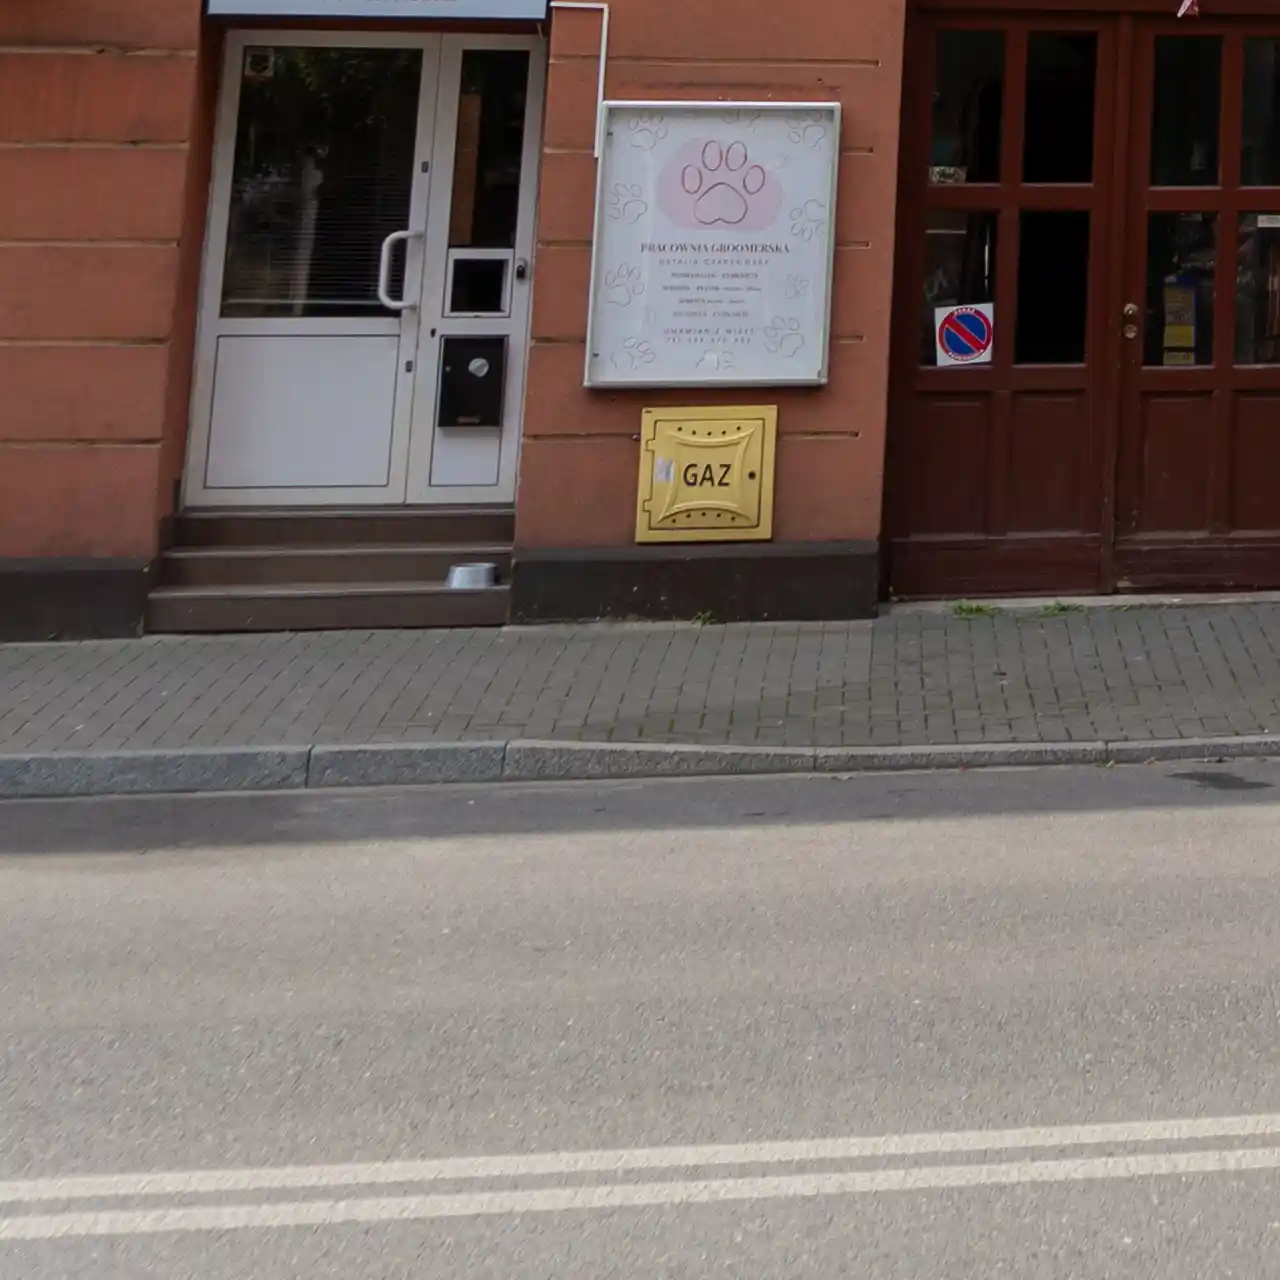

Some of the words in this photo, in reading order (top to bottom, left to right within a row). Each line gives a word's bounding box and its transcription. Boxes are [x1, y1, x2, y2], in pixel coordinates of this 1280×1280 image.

[640, 243, 708, 253] PRACOWNIA
[711, 243, 790, 253] GROOMERSKA
[683, 464, 731, 487] GAZ
